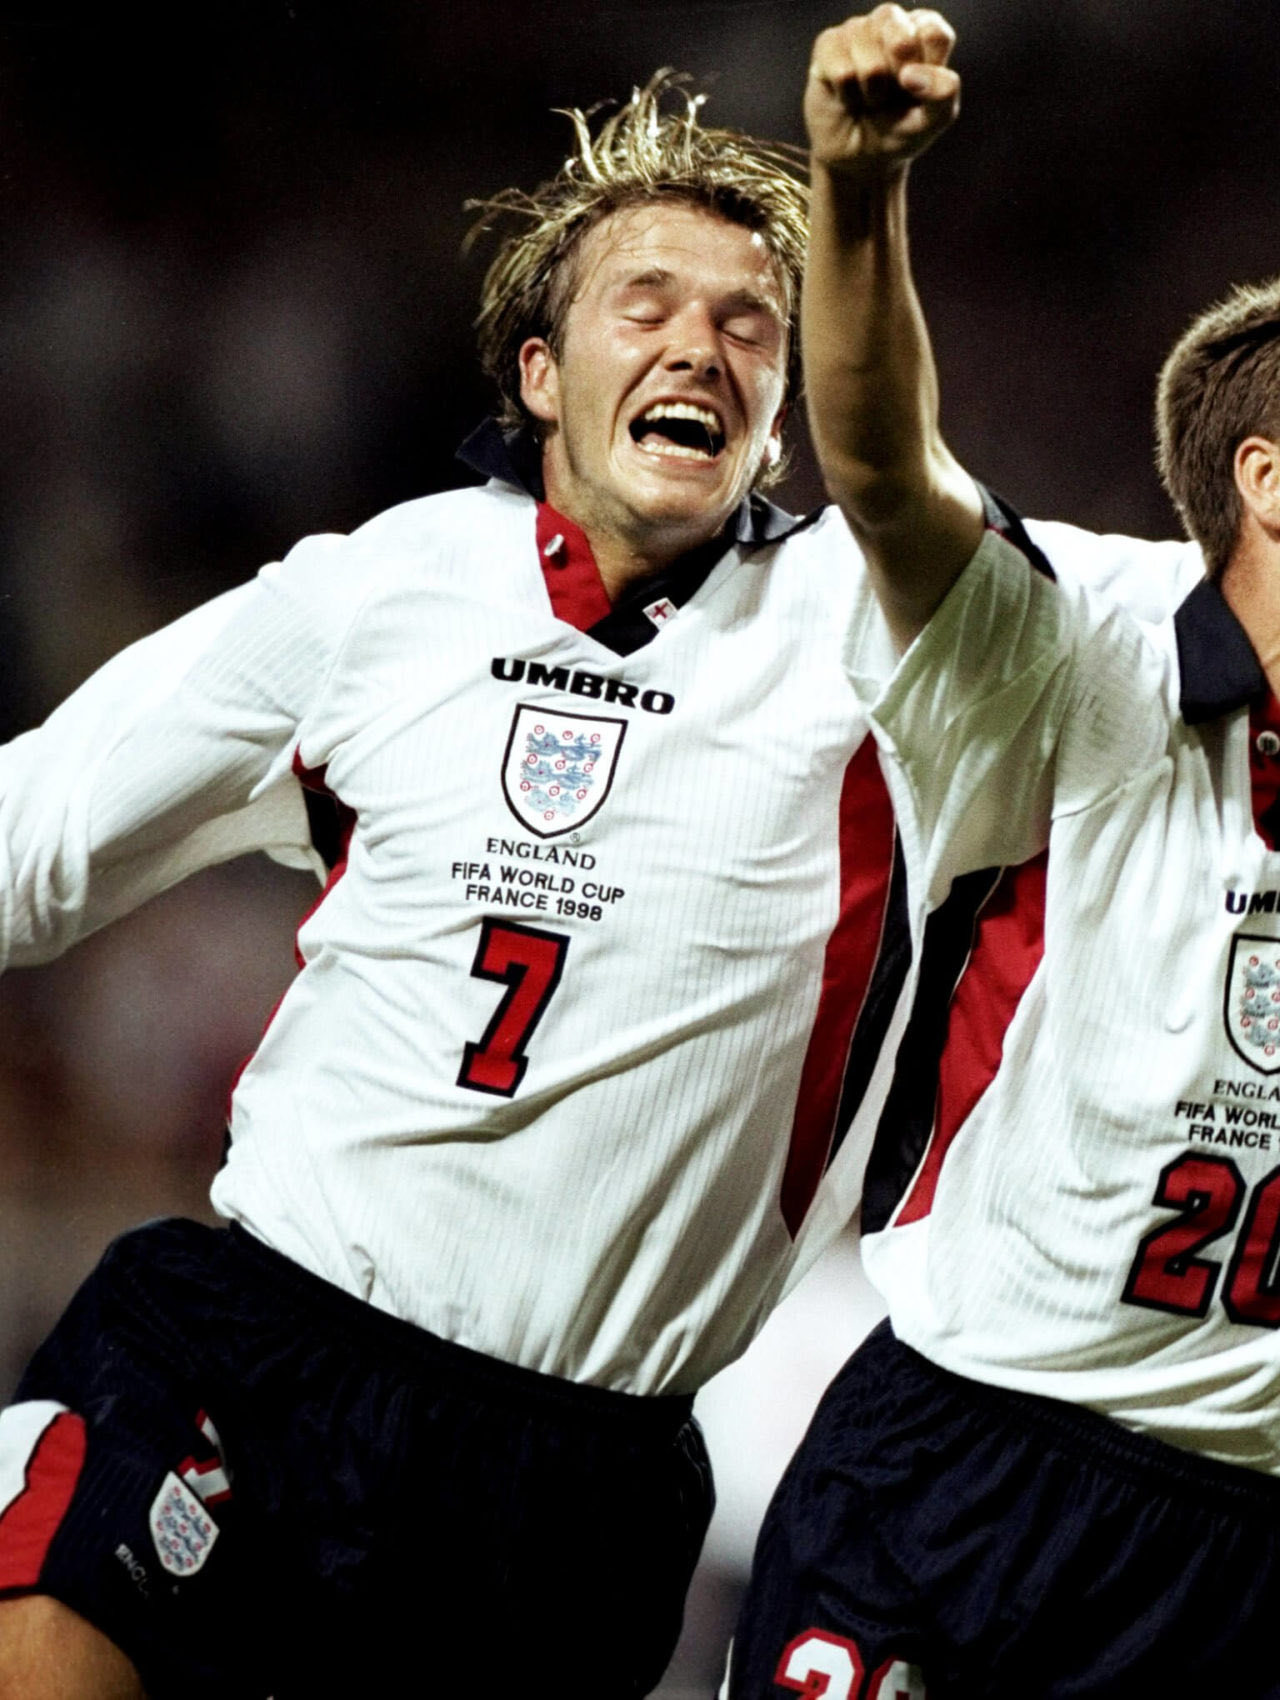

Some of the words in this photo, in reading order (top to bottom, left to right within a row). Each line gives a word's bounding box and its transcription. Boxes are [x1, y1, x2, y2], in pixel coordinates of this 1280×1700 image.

[490, 657, 676, 715] UMBRO
[486, 837, 596, 870] ENGLAND
[451, 862, 492, 888] FIFA
[500, 866, 575, 894] WORLD
[581, 882, 625, 905] CUP
[465, 884, 548, 912] FRANCE
[555, 898, 604, 922] 1998
[456, 915, 571, 1098] 7
[1175, 1100, 1216, 1123] FIFA
[1189, 1123, 1271, 1149] FRANCE
